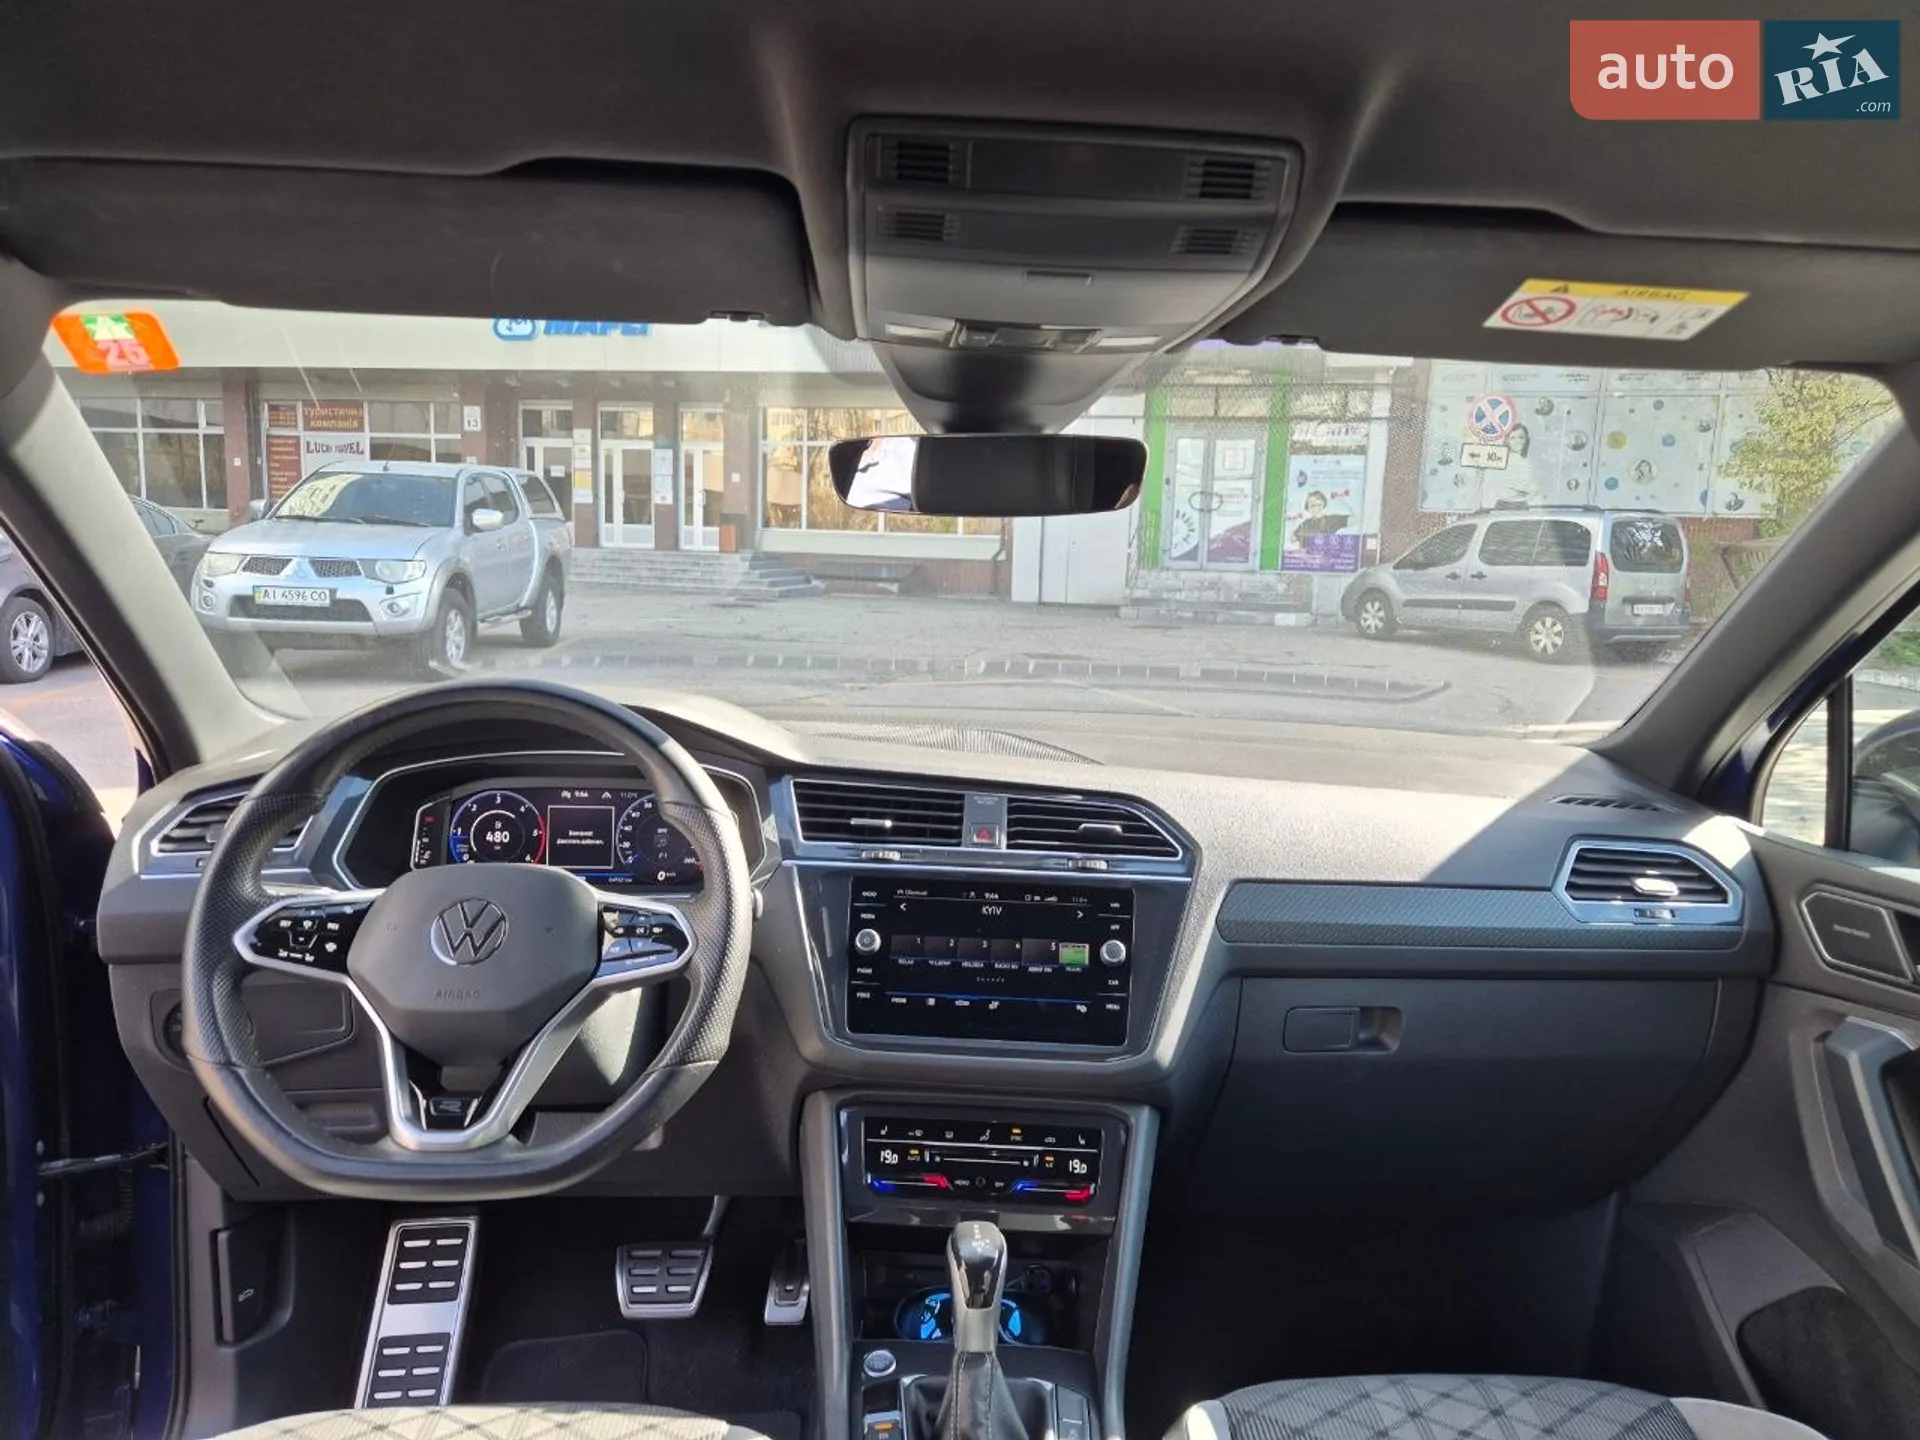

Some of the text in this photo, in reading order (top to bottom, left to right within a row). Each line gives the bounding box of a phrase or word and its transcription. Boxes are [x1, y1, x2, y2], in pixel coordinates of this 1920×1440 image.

[303, 407, 363, 418] туристична
[310, 418, 358, 429] компанія
[486, 832, 510, 843] 480
[982, 904, 1003, 916] KYIV
[434, 989, 481, 1000] AIRBAG
